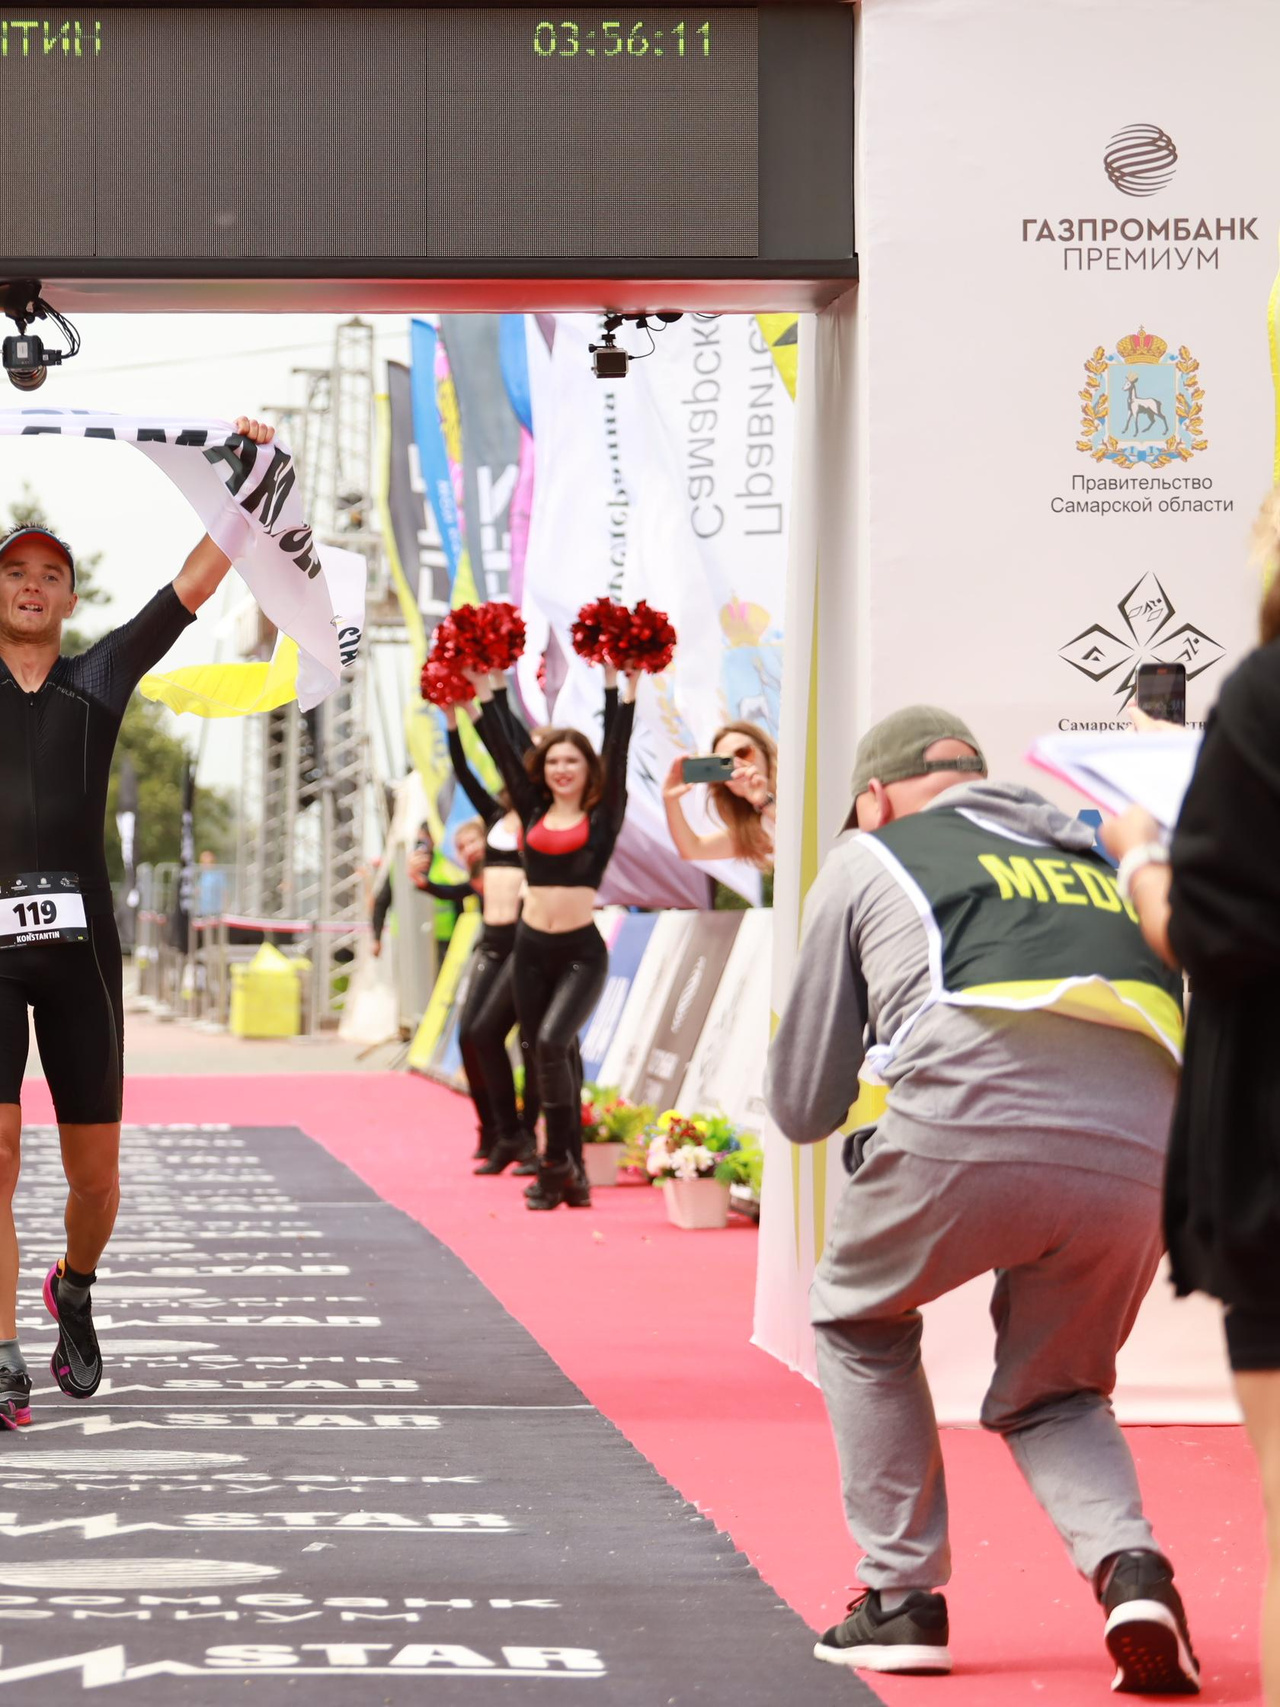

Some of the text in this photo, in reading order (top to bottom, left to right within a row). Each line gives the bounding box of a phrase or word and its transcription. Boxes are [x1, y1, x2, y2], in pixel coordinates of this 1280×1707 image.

[533, 20, 712, 57] 03:56:11
[1021, 216, 1260, 243] ГАЗПРОМБАНК
[1063, 246, 1220, 271] ПРЕМИУМ
[1071, 474, 1214, 495] Правительство
[1050, 495, 1235, 517] Самарской области
[12, 900, 57, 927] 119
[16, 931, 60, 943] KONSTANTIN
[161, 1379, 421, 1389] STAR
[164, 1413, 443, 1427] STAR
[180, 1511, 514, 1527] STAR
[202, 1643, 607, 1671] STAR
